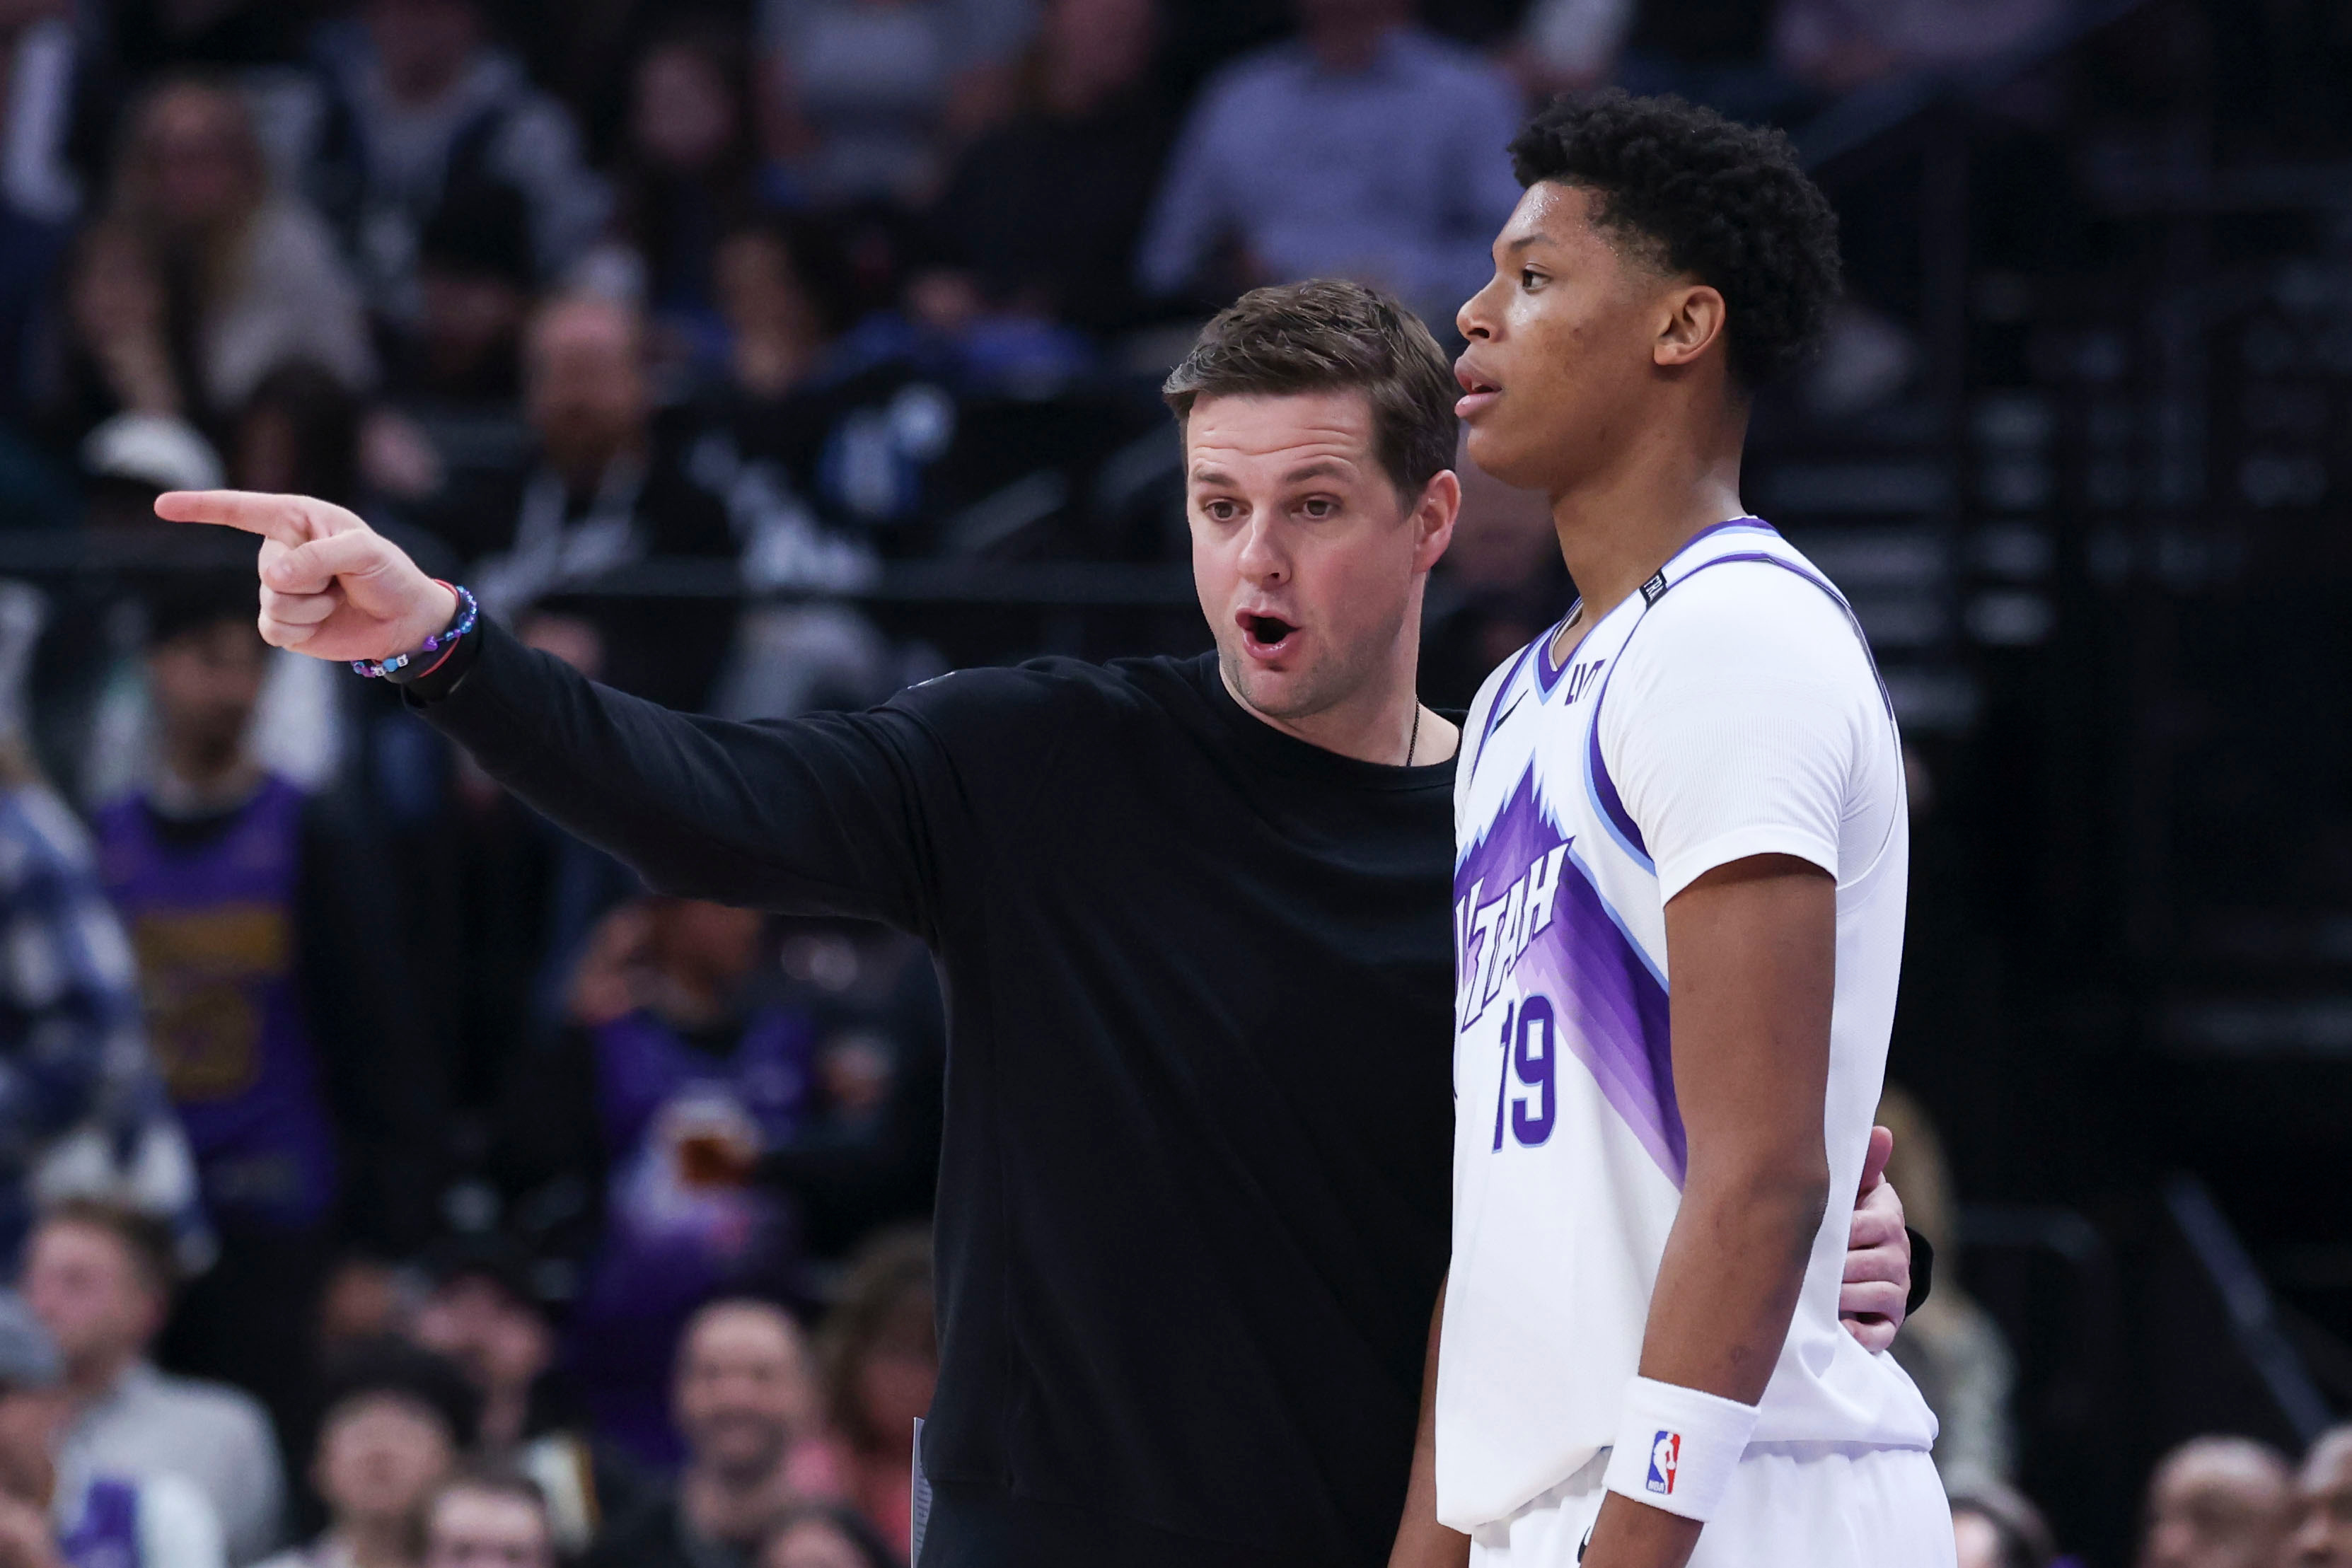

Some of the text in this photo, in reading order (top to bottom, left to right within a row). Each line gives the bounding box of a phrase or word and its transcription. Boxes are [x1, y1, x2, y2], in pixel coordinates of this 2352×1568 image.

[1454, 837, 1573, 1032] UTAH
[1492, 993, 1556, 1154] 19
[1647, 1480, 1664, 1493] NBA
